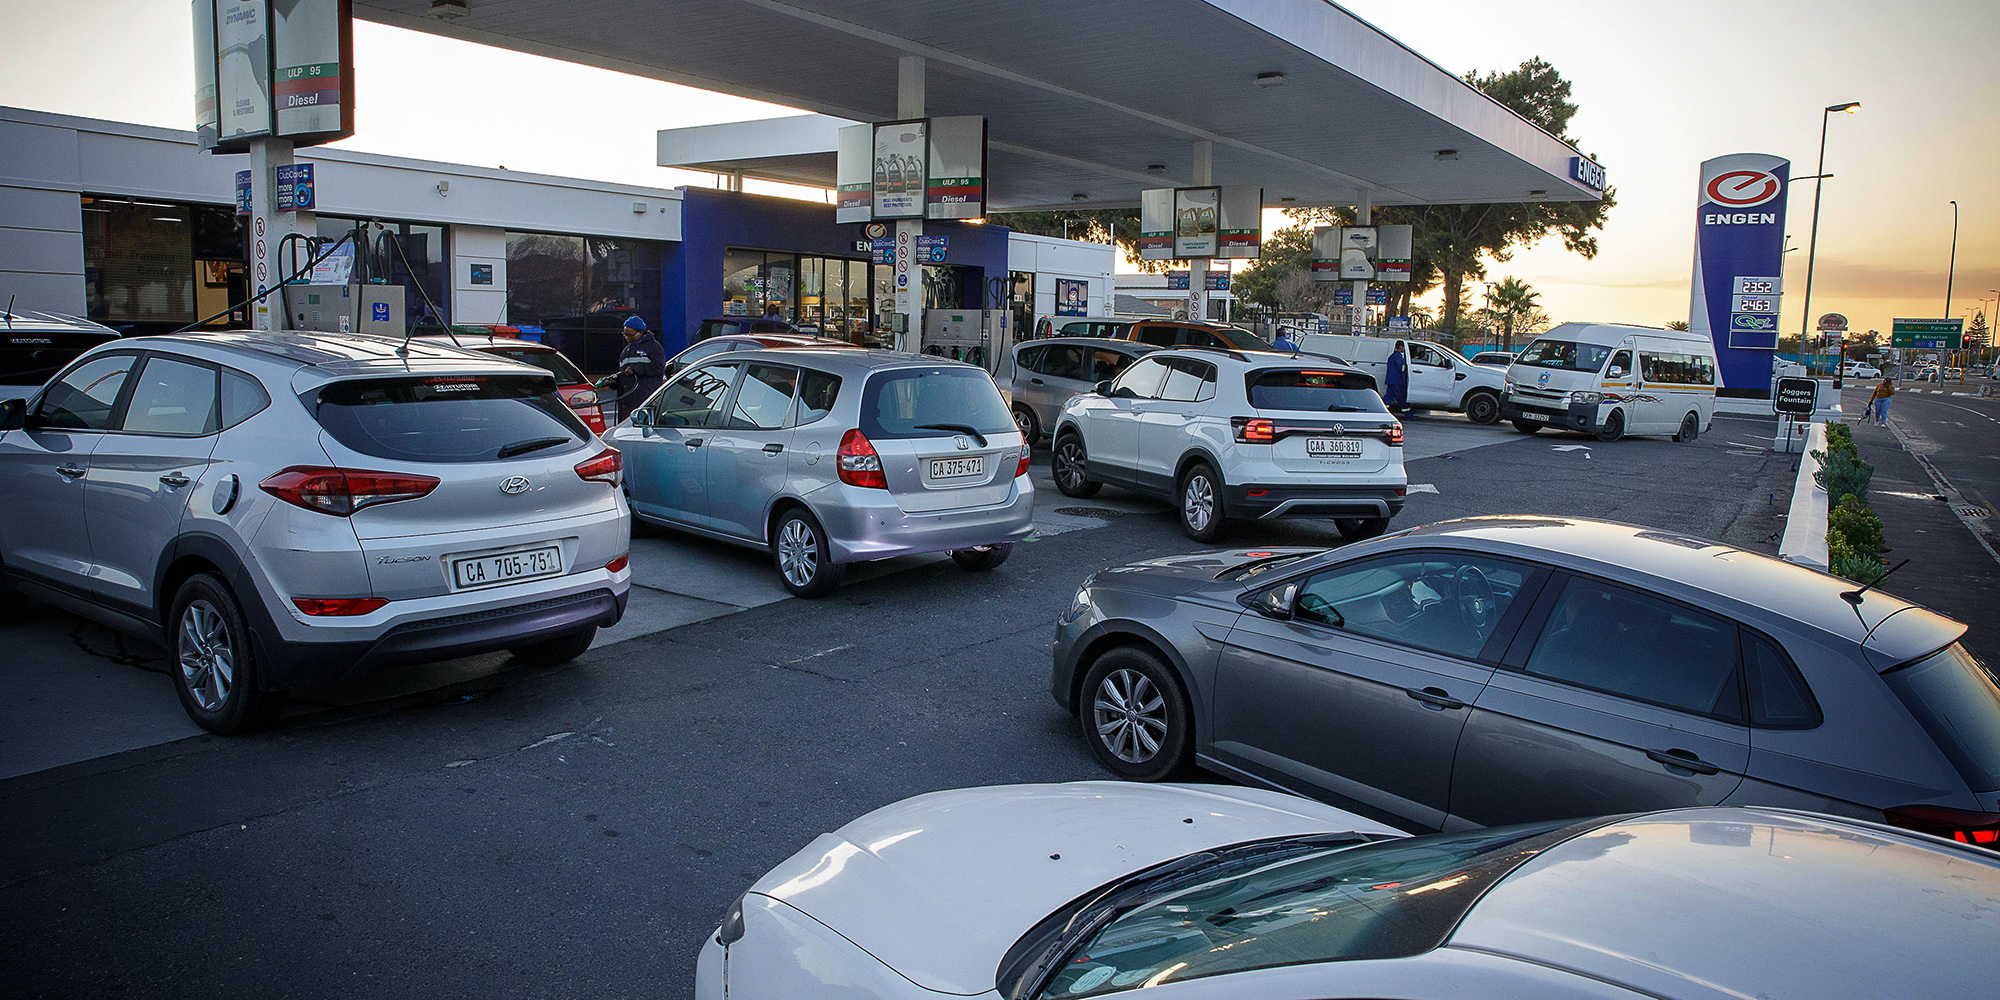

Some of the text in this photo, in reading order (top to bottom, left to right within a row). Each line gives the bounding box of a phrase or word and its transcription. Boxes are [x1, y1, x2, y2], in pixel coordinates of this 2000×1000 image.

[287, 66, 321, 78] ULP 95
[288, 93, 319, 107] Diesel
[279, 170, 303, 180] ClubCard
[1578, 158, 1606, 192] ENGEN
[960, 178, 969, 186] 95
[278, 184, 293, 192] more
[278, 195, 293, 204] more
[843, 200, 861, 208] Diesel
[941, 195, 967, 203] Diesel
[1704, 213, 1776, 225] ENGEN
[130, 250, 175, 262] Training
[1781, 388, 1811, 397] Joggers
[1779, 395, 1811, 404] Fountain
[1310, 440, 1360, 452] CAA 360-819
[933, 459, 982, 476] CA 375-471
[375, 554, 432, 565] TUCSON
[465, 551, 556, 582] CA 705-751
